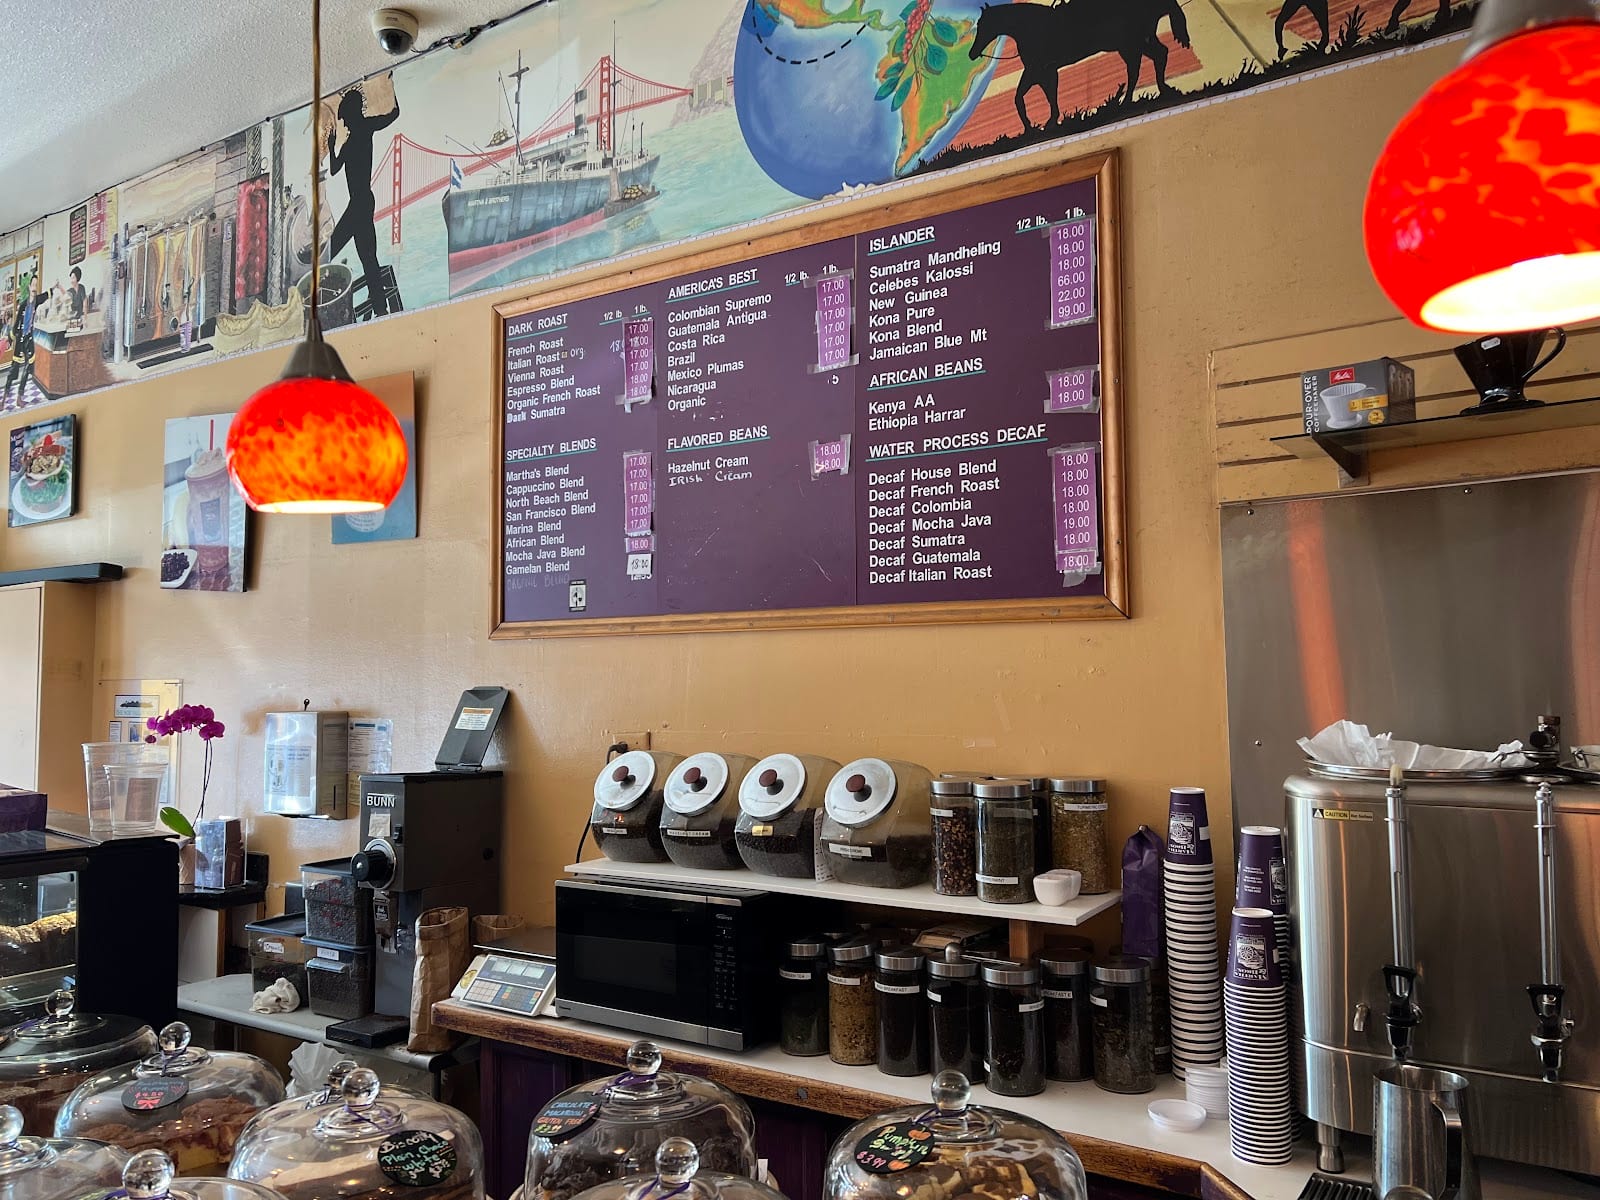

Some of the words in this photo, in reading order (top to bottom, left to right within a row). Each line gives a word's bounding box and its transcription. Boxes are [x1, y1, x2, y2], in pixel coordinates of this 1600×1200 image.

[1065, 209, 1070, 218] 1
[1073, 207, 1086, 218] lb.
[1017, 218, 1031, 230] 1/2
[1036, 216, 1048, 226] lb.
[869, 227, 935, 252] ISLANDER
[1057, 225, 1084, 240] 18.00
[1058, 240, 1084, 255] 18.00
[869, 258, 920, 279] Sumatra
[928, 241, 1001, 266] Mandheling
[1058, 256, 1085, 271] 18.00
[823, 266, 827, 274] 1
[829, 264, 838, 273] lb.
[668, 277, 723, 299] AMERICA'S
[729, 269, 757, 285] BEST
[785, 273, 796, 284] 1/2
[800, 272, 809, 280] lb.
[869, 276, 919, 295] Celebes
[926, 262, 973, 283] Kalossi
[1058, 272, 1085, 286] 66.00
[822, 280, 844, 293] 17.00
[823, 294, 844, 306] 17.00
[869, 298, 895, 311] New
[905, 287, 948, 304] Guinea
[1058, 287, 1085, 302] 22.00
[635, 305, 638, 313] 1
[668, 305, 720, 323] Colombian
[725, 293, 772, 311] Supremo
[824, 308, 845, 320] 17.00
[1059, 302, 1085, 318] 99.00
[668, 319, 720, 338] Guatemala
[727, 310, 767, 326] Antigua
[869, 312, 900, 328] Kona
[906, 305, 935, 321] Pure
[508, 321, 532, 336] DARK
[538, 313, 568, 330] ROAST
[629, 324, 648, 334] 17.00
[825, 322, 844, 334] 17.00
[869, 328, 900, 344] Kona
[906, 320, 942, 338] Blend
[508, 344, 534, 358] French
[539, 338, 564, 352] Roast
[668, 340, 696, 352] Costa
[703, 334, 725, 346] Rica
[825, 335, 844, 348] 17.00
[869, 340, 928, 361] Jamaican
[935, 333, 962, 349] Blue
[970, 328, 987, 343] Mt
[508, 358, 531, 370] Italian
[536, 352, 560, 365] Roast
[630, 350, 648, 359] 17.00
[668, 352, 695, 367] Brazil
[825, 349, 844, 361] 17.00
[631, 361, 648, 372] 17.00
[668, 367, 702, 382] Mexico
[708, 360, 744, 375] Plumas
[869, 366, 928, 388] AFRICAN
[935, 358, 983, 377] BEANS
[508, 370, 535, 384] Vienna
[540, 365, 564, 378] Roast
[631, 375, 647, 384] 18.00
[1058, 374, 1084, 388] 18.00
[507, 382, 546, 397] Espresso
[551, 376, 575, 389] Blend
[631, 385, 647, 396] 18.00
[668, 380, 716, 396] Nicaragua
[507, 396, 538, 411] Organic
[543, 391, 571, 405] French
[576, 385, 600, 397] Roast
[668, 396, 706, 412] Organic
[1058, 390, 1084, 404] 18.00
[1312, 376, 1320, 432] COFFEEMAKER
[531, 405, 565, 420] Sumatra
[869, 400, 906, 415] Kenya
[869, 414, 918, 431] Ethiopia
[925, 407, 966, 423] Harrar
[668, 432, 723, 449] FLAVORED
[730, 425, 767, 441] BEANS
[869, 441, 914, 458] WATER
[924, 432, 988, 451] PROCESS
[997, 424, 1046, 443] DECAF
[507, 445, 554, 460] SPECIALTY
[560, 438, 596, 453] BLENDS
[820, 444, 840, 455] 18.00
[630, 457, 647, 466] 17.00
[668, 460, 710, 474] Hazelnut
[715, 456, 748, 468] Cream
[1061, 453, 1088, 466] 18.00
[506, 469, 540, 481] Martha's
[545, 464, 569, 477] Blend
[630, 470, 647, 479] 17.00
[869, 470, 905, 485] Decaf
[911, 467, 951, 481] House
[959, 459, 996, 475] Blend
[1062, 469, 1088, 482] 18.00
[507, 482, 555, 496] Cappuccino
[560, 477, 584, 488] Blend
[630, 482, 647, 491] 17.00
[869, 487, 905, 502] Decaf
[911, 482, 953, 498] French
[961, 478, 1000, 493] Roast
[1062, 485, 1088, 497] 18.00
[506, 496, 529, 508] North
[534, 492, 560, 505] Beach
[564, 490, 589, 501] Blend
[630, 494, 647, 503] 17.00
[506, 511, 522, 522] San
[526, 506, 566, 520] Francisco
[571, 503, 596, 514] Blend
[631, 507, 647, 516] 17.00
[869, 503, 905, 518] Decaf
[912, 498, 972, 514] Colombia
[1063, 500, 1089, 513] 18.00
[506, 524, 533, 535] Marina
[538, 520, 562, 532] Blend
[631, 520, 647, 528] 17.00
[869, 520, 905, 535] Decaf
[912, 517, 954, 532] Mocha
[961, 514, 991, 528] Java
[1064, 516, 1089, 529] 19.00
[506, 536, 536, 548] African
[541, 534, 564, 546] Blend
[631, 540, 648, 548] 18.00
[869, 536, 905, 551] Decaf
[912, 533, 965, 548] Sumatra
[1064, 532, 1090, 544] 18.00
[506, 550, 533, 562] Mocha
[537, 548, 556, 560] Java
[561, 546, 585, 557] Blend
[869, 553, 905, 568] Decaf
[912, 549, 980, 565] Guatemala
[506, 564, 541, 575] Gamelan
[546, 561, 570, 572] Blend
[869, 569, 905, 584] Decaf
[909, 568, 946, 582] Italian
[954, 565, 992, 580] Roast
[366, 796, 395, 808] BUNN
